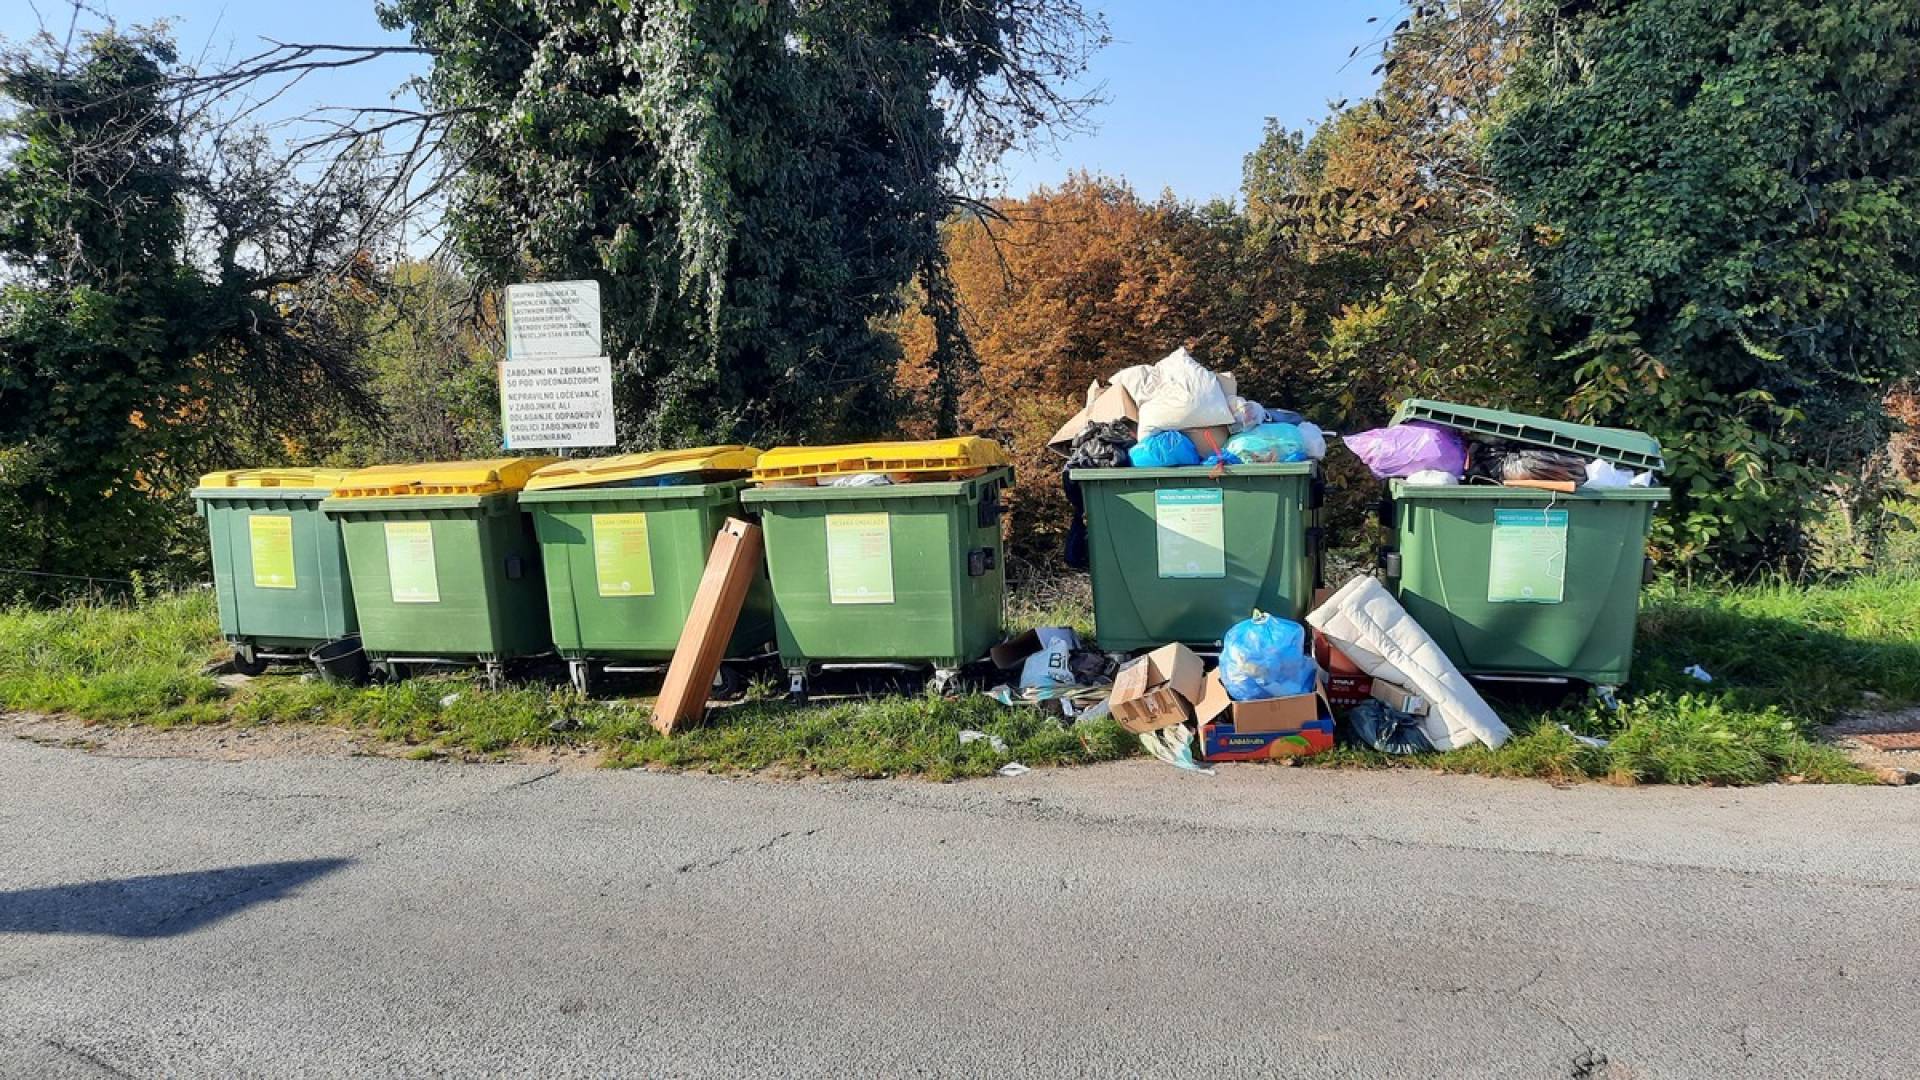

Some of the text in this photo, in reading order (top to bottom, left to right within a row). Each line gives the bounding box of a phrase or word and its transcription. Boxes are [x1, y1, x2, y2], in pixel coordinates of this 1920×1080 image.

[506, 365, 601, 377] ZABOJNIKI NA ZBIRALNICI
[507, 376, 600, 388] SO POD VIDEONADZOROM
[508, 391, 554, 400] NEPRAVILNO
[509, 403, 514, 411] V
[559, 402, 570, 410] ALI
[510, 421, 600, 432] OKOLICI ZABOJNIKOV BO
[512, 433, 572, 442] SANKCIONIRANO
